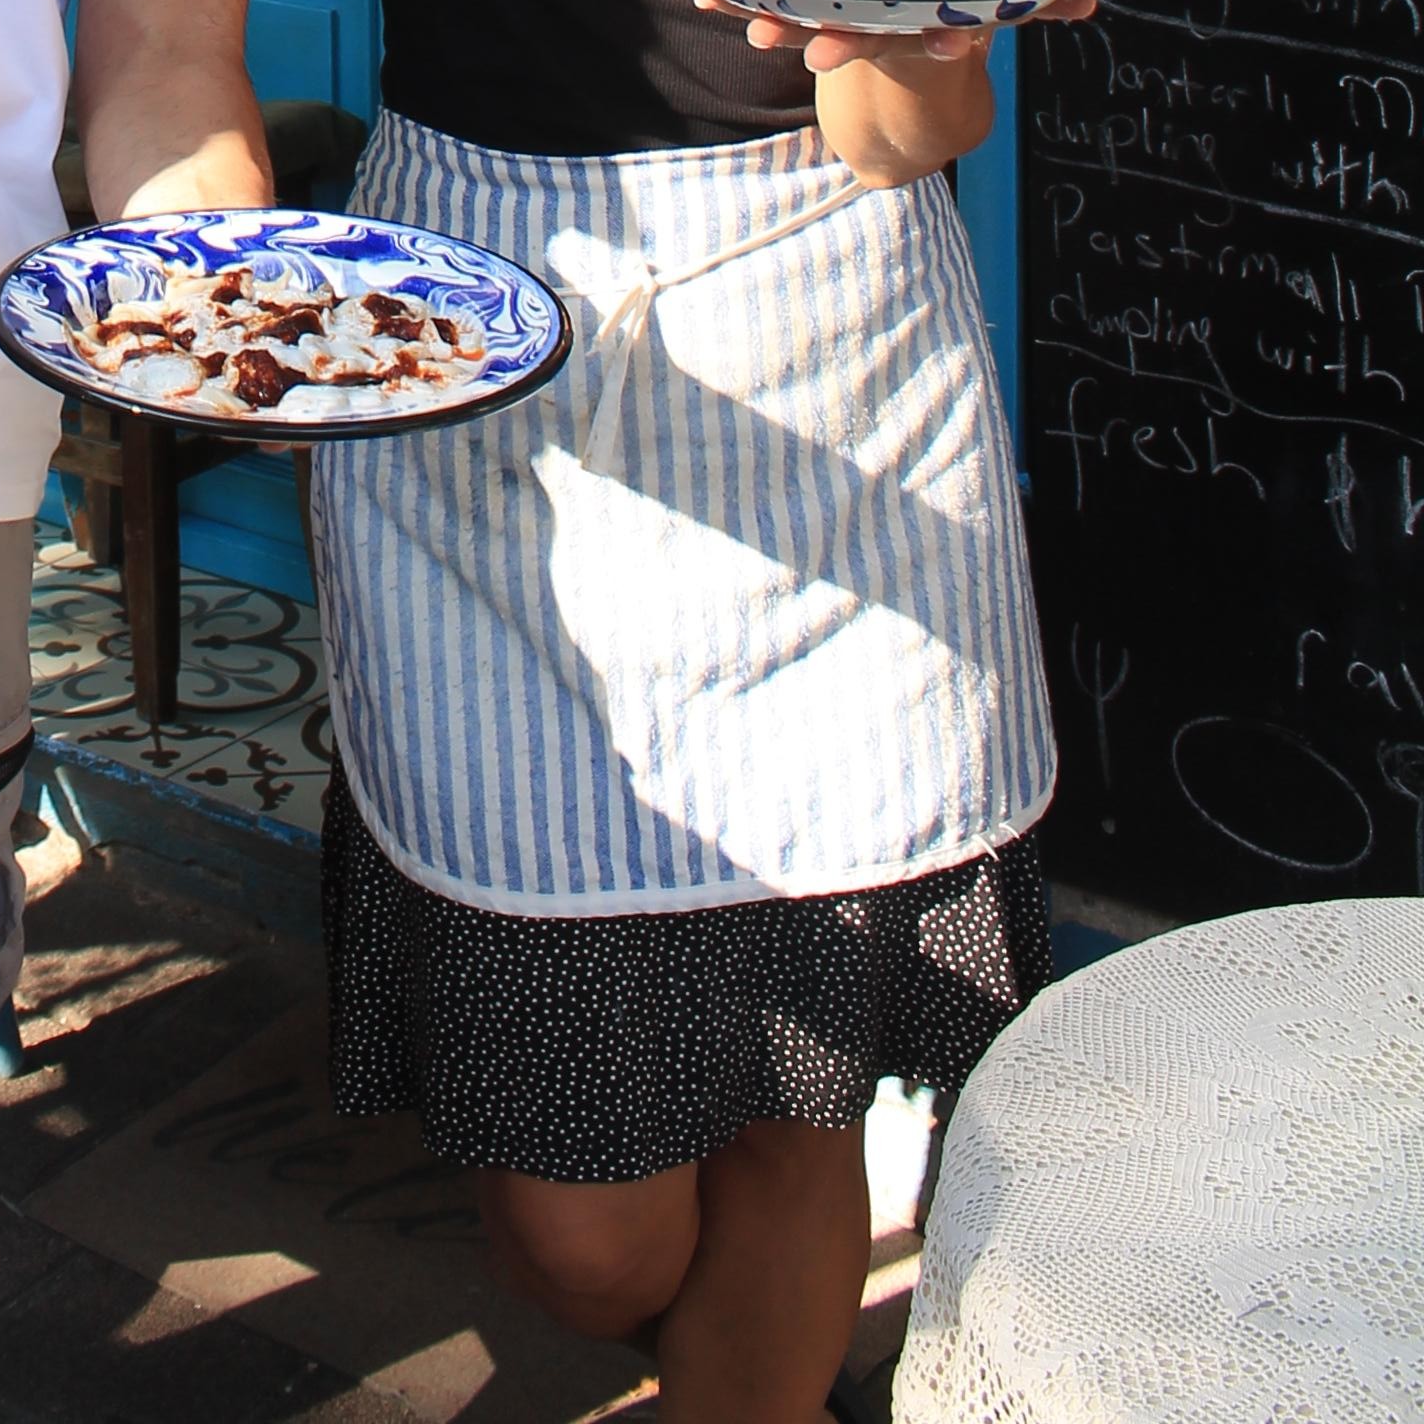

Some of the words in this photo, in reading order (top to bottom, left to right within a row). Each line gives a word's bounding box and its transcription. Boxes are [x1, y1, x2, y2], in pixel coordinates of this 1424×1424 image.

[1273, 138, 1412, 214] with
[1257, 324, 1407, 403] with
[1045, 376, 1267, 512] fresh
